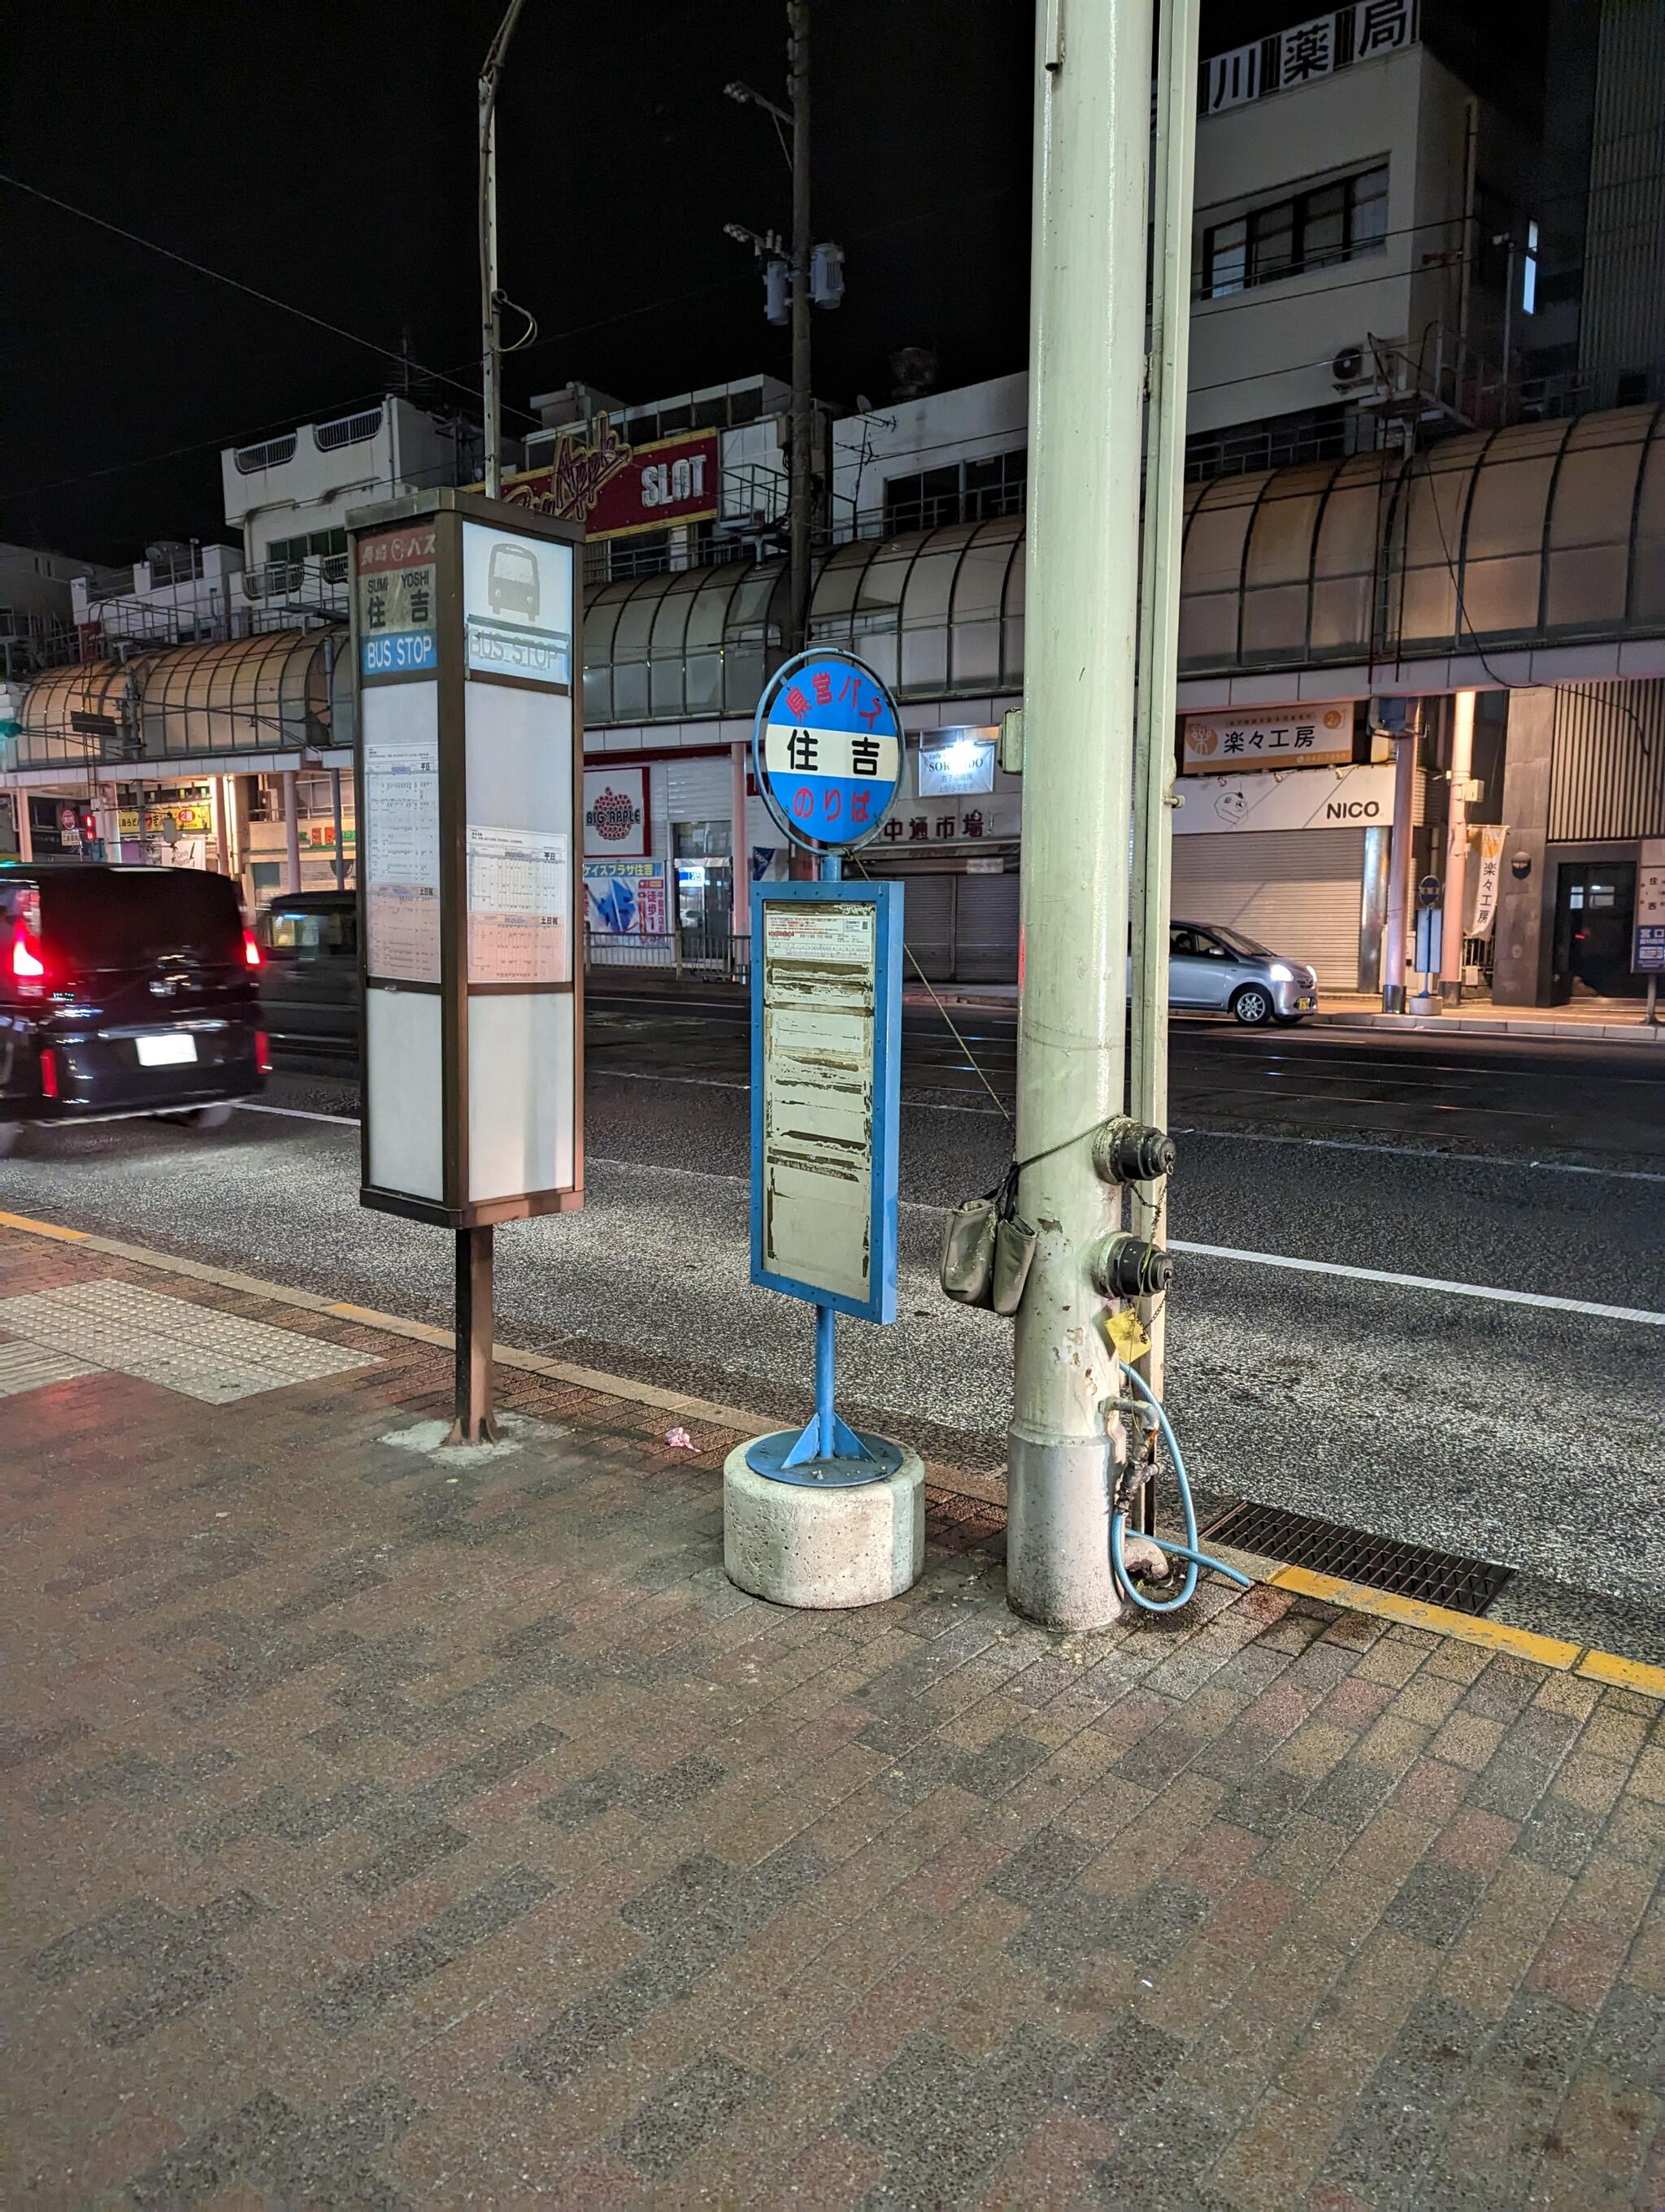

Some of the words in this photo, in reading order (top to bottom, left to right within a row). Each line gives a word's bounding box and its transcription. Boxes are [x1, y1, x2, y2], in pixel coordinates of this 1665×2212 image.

[1211, 0, 1406, 108] 川薬局
[641, 454, 707, 507] SLOT
[367, 576, 389, 594] SUMI
[401, 569, 429, 589] YOSHI
[367, 589, 429, 629] 住吉
[367, 640, 392, 668] BUS
[397, 635, 432, 666] STOP
[470, 629, 505, 661] BUS
[511, 637, 559, 670] STOP
[787, 728, 880, 776] 住吉
[1224, 725, 1315, 754] 楽々工房
[586, 811, 605, 824] BIG
[609, 808, 641, 824] APPLE
[793, 788, 870, 823] のりば
[1326, 801, 1380, 819] NICO
[884, 808, 985, 841] 中通市場
[1476, 862, 1497, 923] 楽々工房
